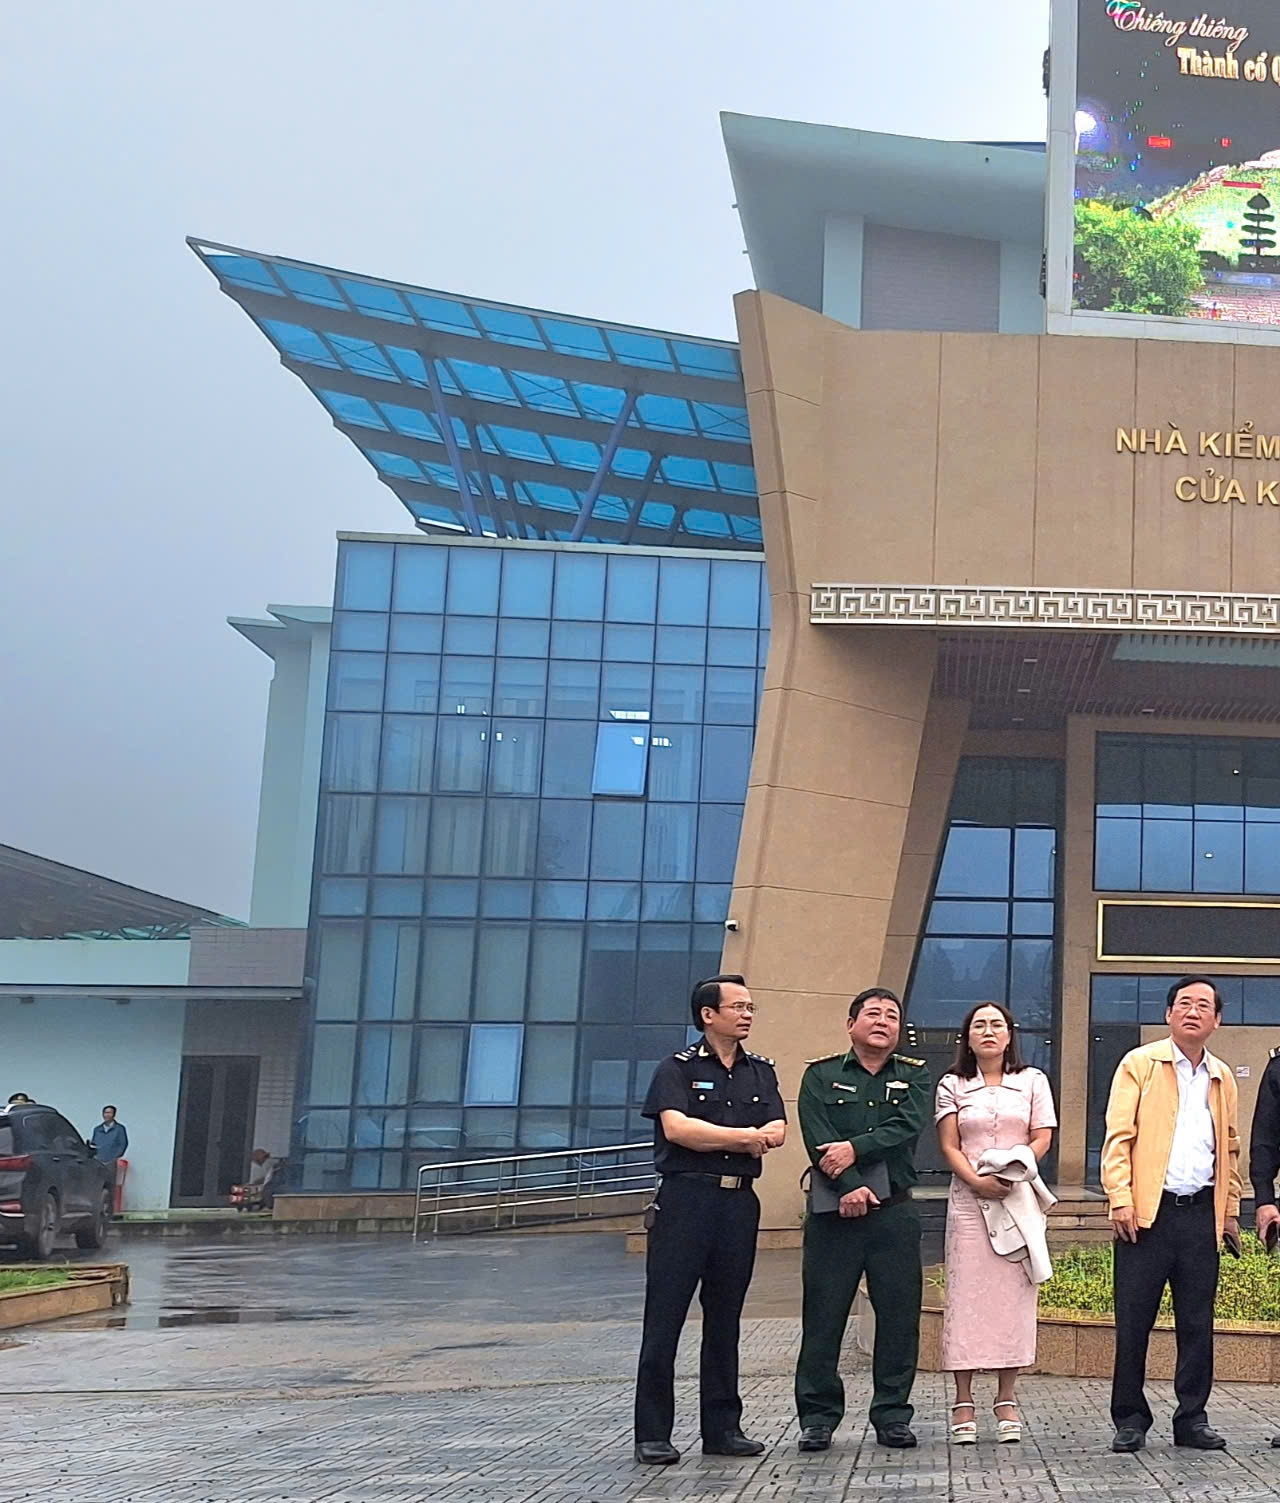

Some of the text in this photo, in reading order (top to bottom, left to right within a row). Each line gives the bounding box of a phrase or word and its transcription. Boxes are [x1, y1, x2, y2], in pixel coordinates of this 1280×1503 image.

[1177, 47, 1239, 80] Thành
[1244, 52, 1268, 82] cổ
[1115, 422, 1188, 457] NHÀ
[1199, 420, 1280, 460] KIỂM
[1174, 468, 1246, 504] CỬA
